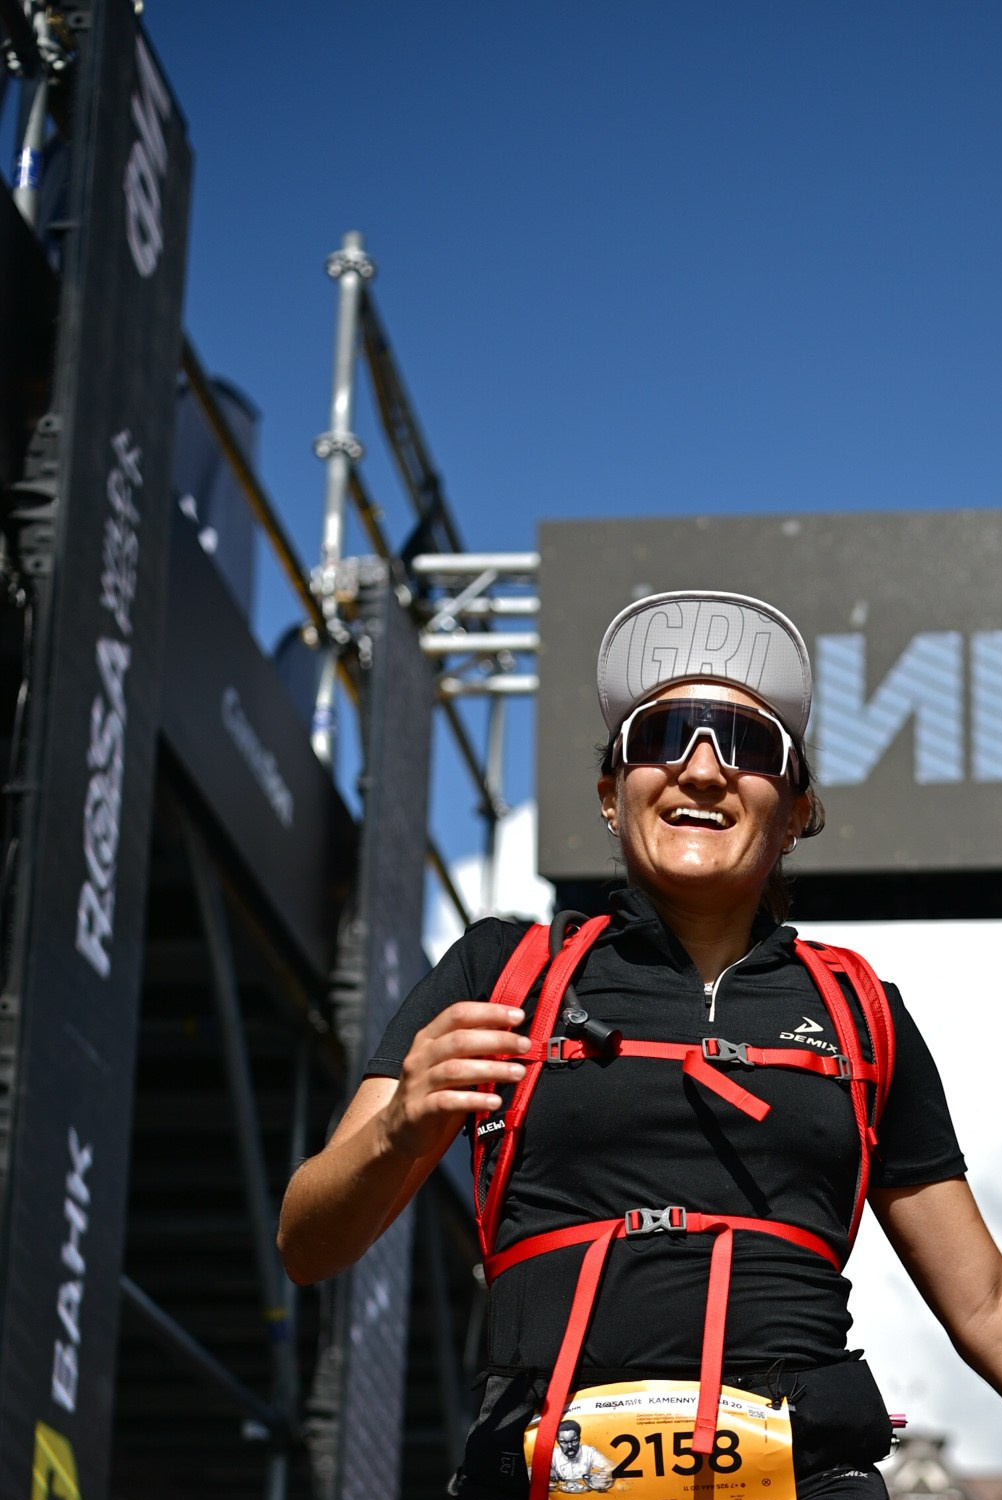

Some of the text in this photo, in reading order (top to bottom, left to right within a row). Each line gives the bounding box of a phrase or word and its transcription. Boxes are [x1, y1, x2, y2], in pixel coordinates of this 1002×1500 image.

[779, 1031, 839, 1054] DEMIX
[50, 1126, 94, 1414] БАНК
[648, 1397, 697, 1405] KAMENNY
[610, 1429, 744, 1479] 2158
